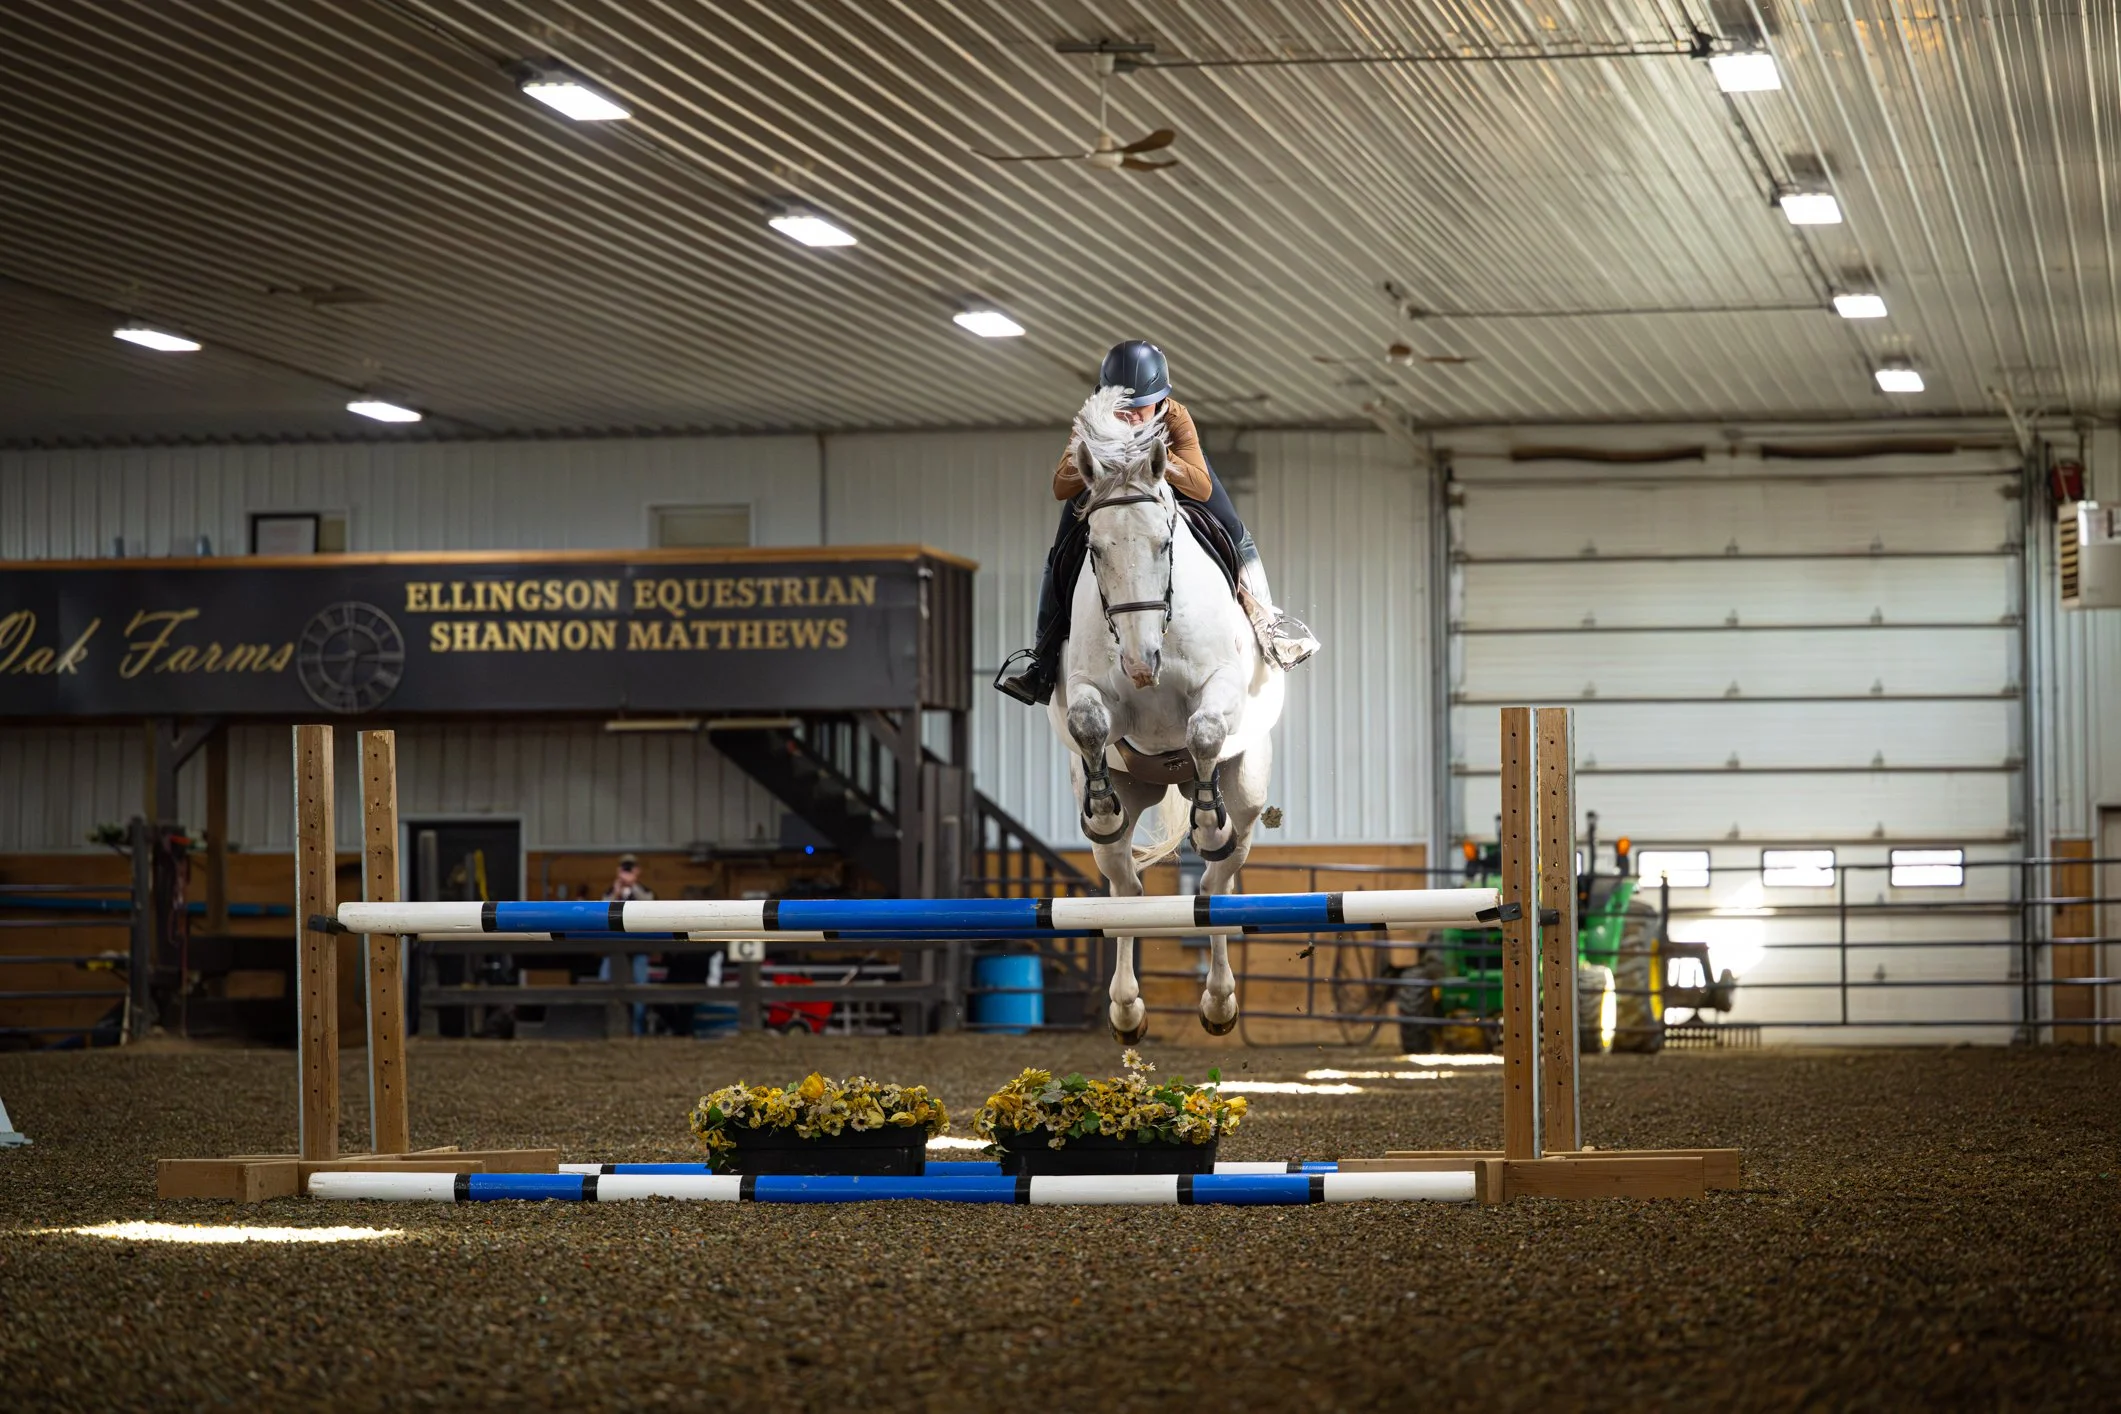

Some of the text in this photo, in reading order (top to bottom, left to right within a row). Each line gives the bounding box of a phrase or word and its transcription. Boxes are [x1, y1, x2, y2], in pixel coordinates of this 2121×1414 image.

[405, 575, 878, 617] ELLINGSON EQUESTRIAN
[0, 607, 295, 679] Oak Farms
[430, 617, 849, 652] SHANNON MATTHEWS
